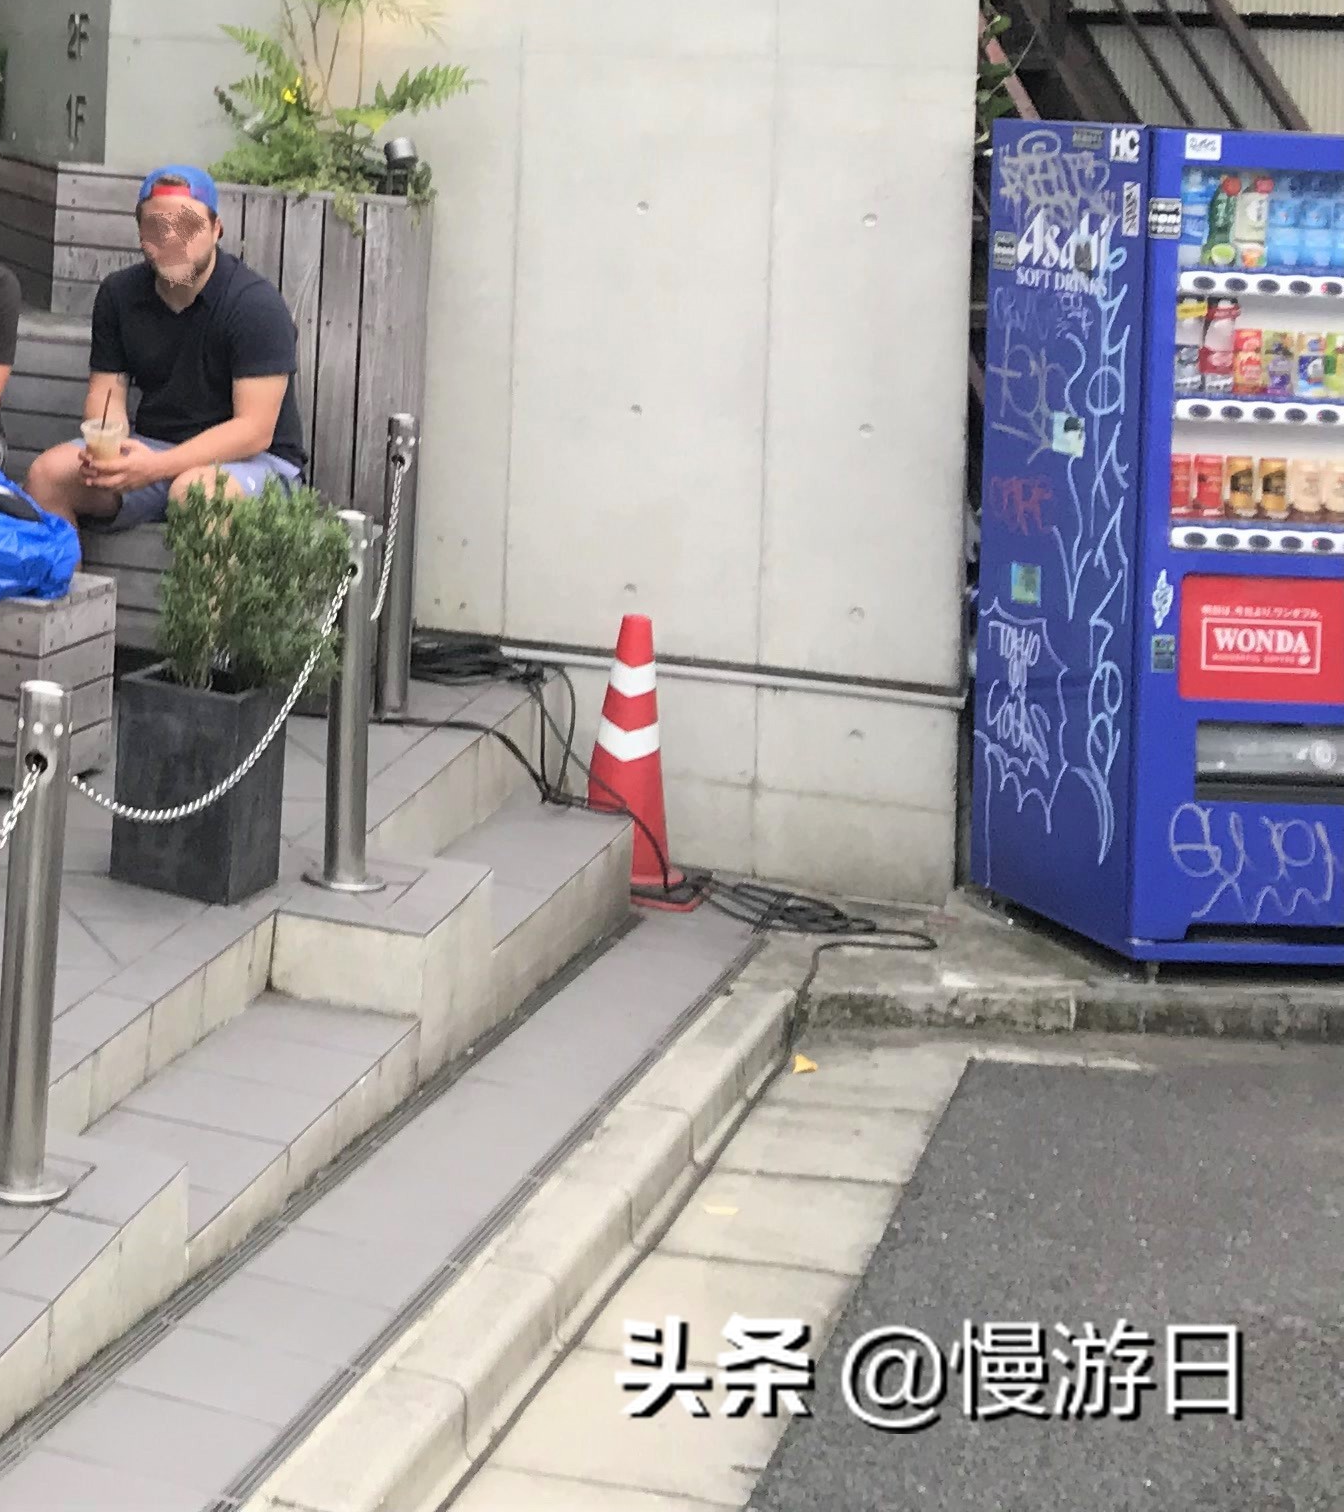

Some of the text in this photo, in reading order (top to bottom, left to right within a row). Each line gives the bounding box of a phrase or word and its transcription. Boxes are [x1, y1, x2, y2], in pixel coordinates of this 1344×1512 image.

[67, 12, 90, 60] 2F
[66, 93, 87, 142] 1F
[1016, 268, 1052, 287] SOFT
[1213, 627, 1311, 654] WONDA
